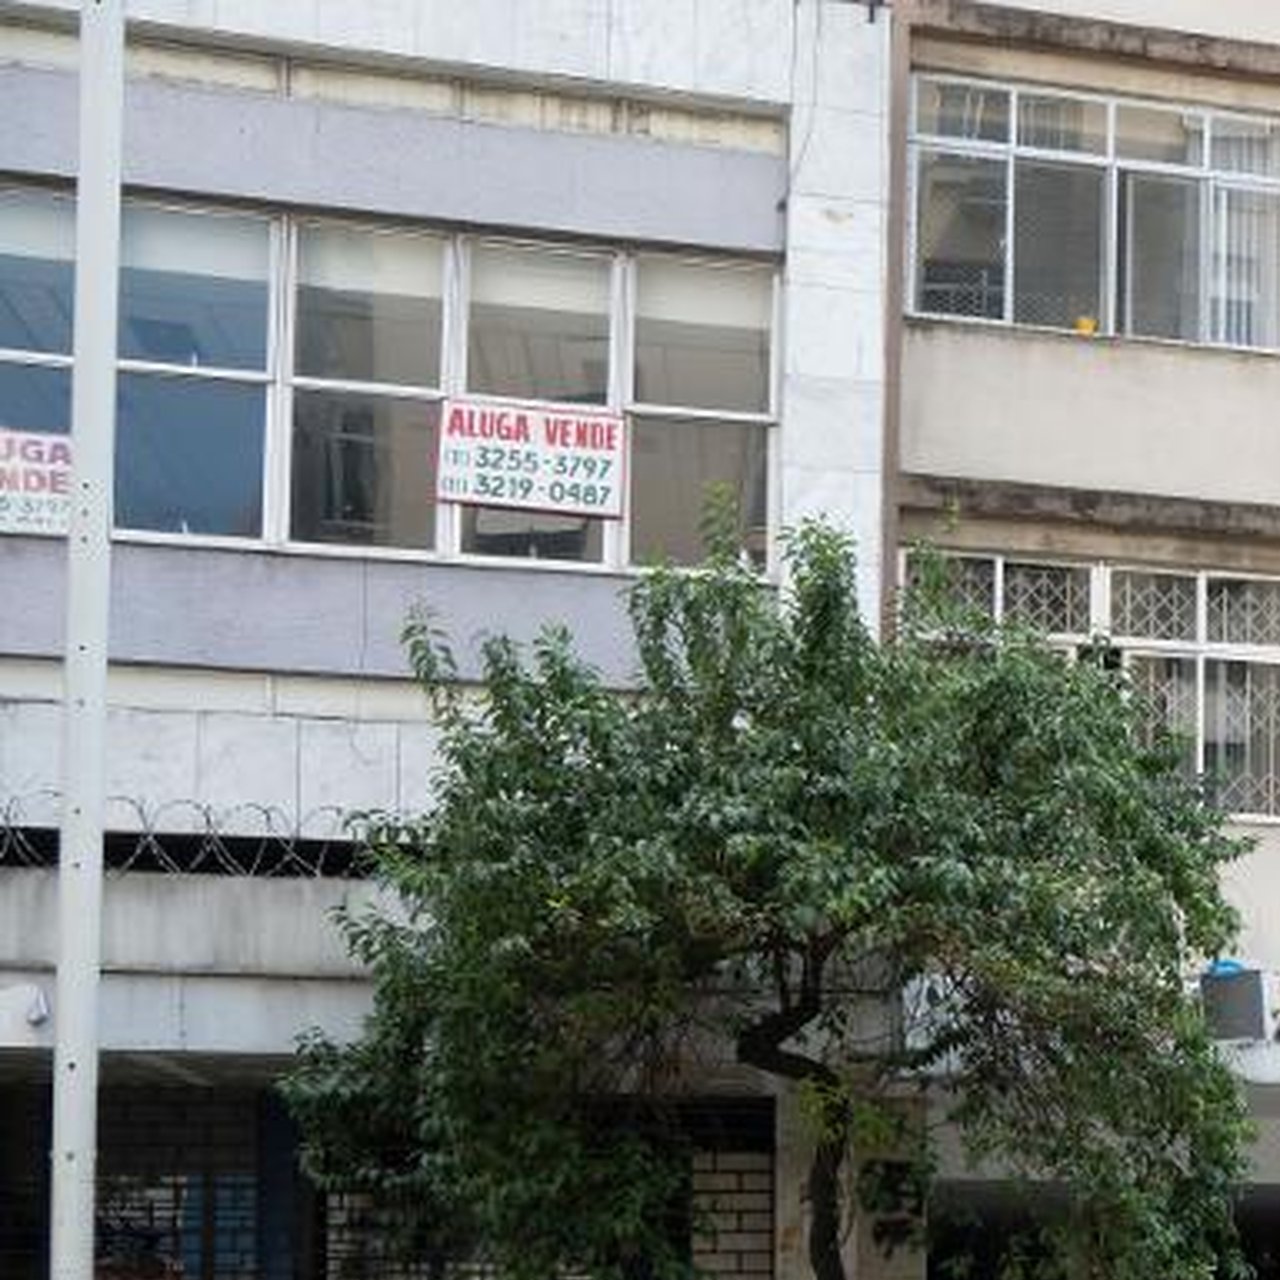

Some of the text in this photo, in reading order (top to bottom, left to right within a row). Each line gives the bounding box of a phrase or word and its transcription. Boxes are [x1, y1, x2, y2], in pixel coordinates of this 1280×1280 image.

[447, 408, 618, 450] ALUGA VENDE
[476, 446, 613, 479] 3255-3797
[473, 473, 612, 505] 3219-0487
